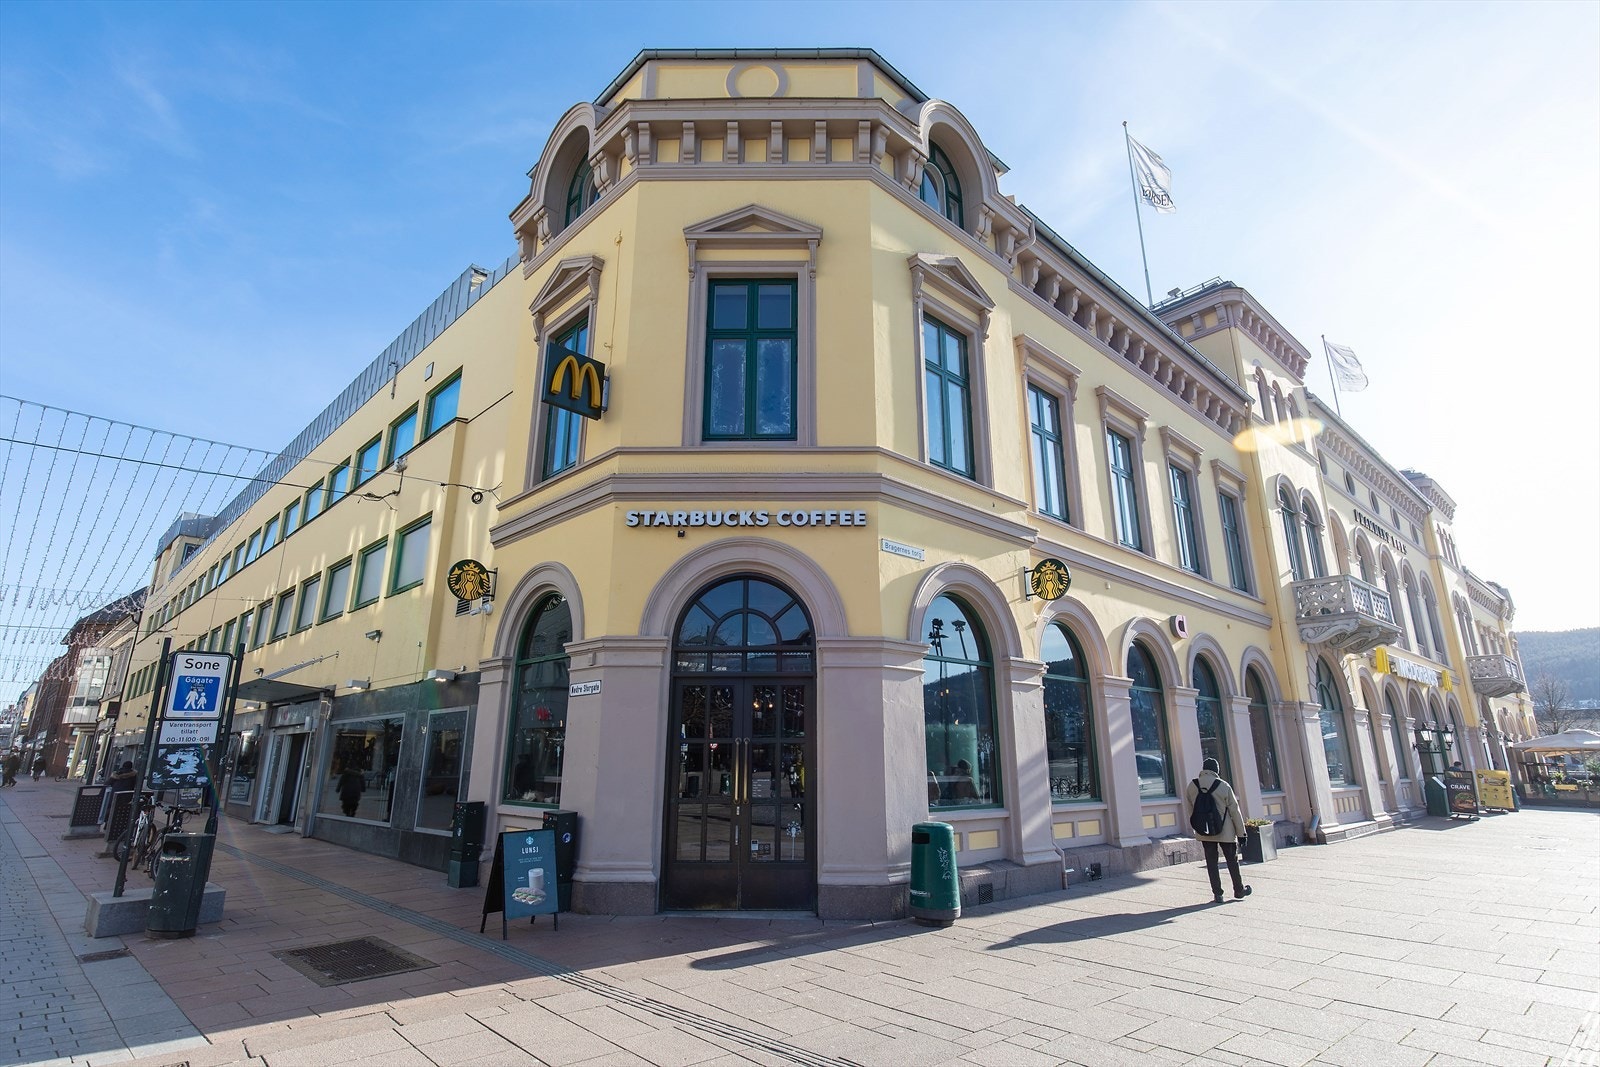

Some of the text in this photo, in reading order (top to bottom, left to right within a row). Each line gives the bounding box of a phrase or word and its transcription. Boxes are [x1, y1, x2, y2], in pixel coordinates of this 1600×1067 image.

[625, 510, 867, 527] STARBUCKS COFFEE
[184, 658, 220, 670] Sone
[185, 676, 214, 684] Gågate
[521, 846, 539, 854] LUNSJ
